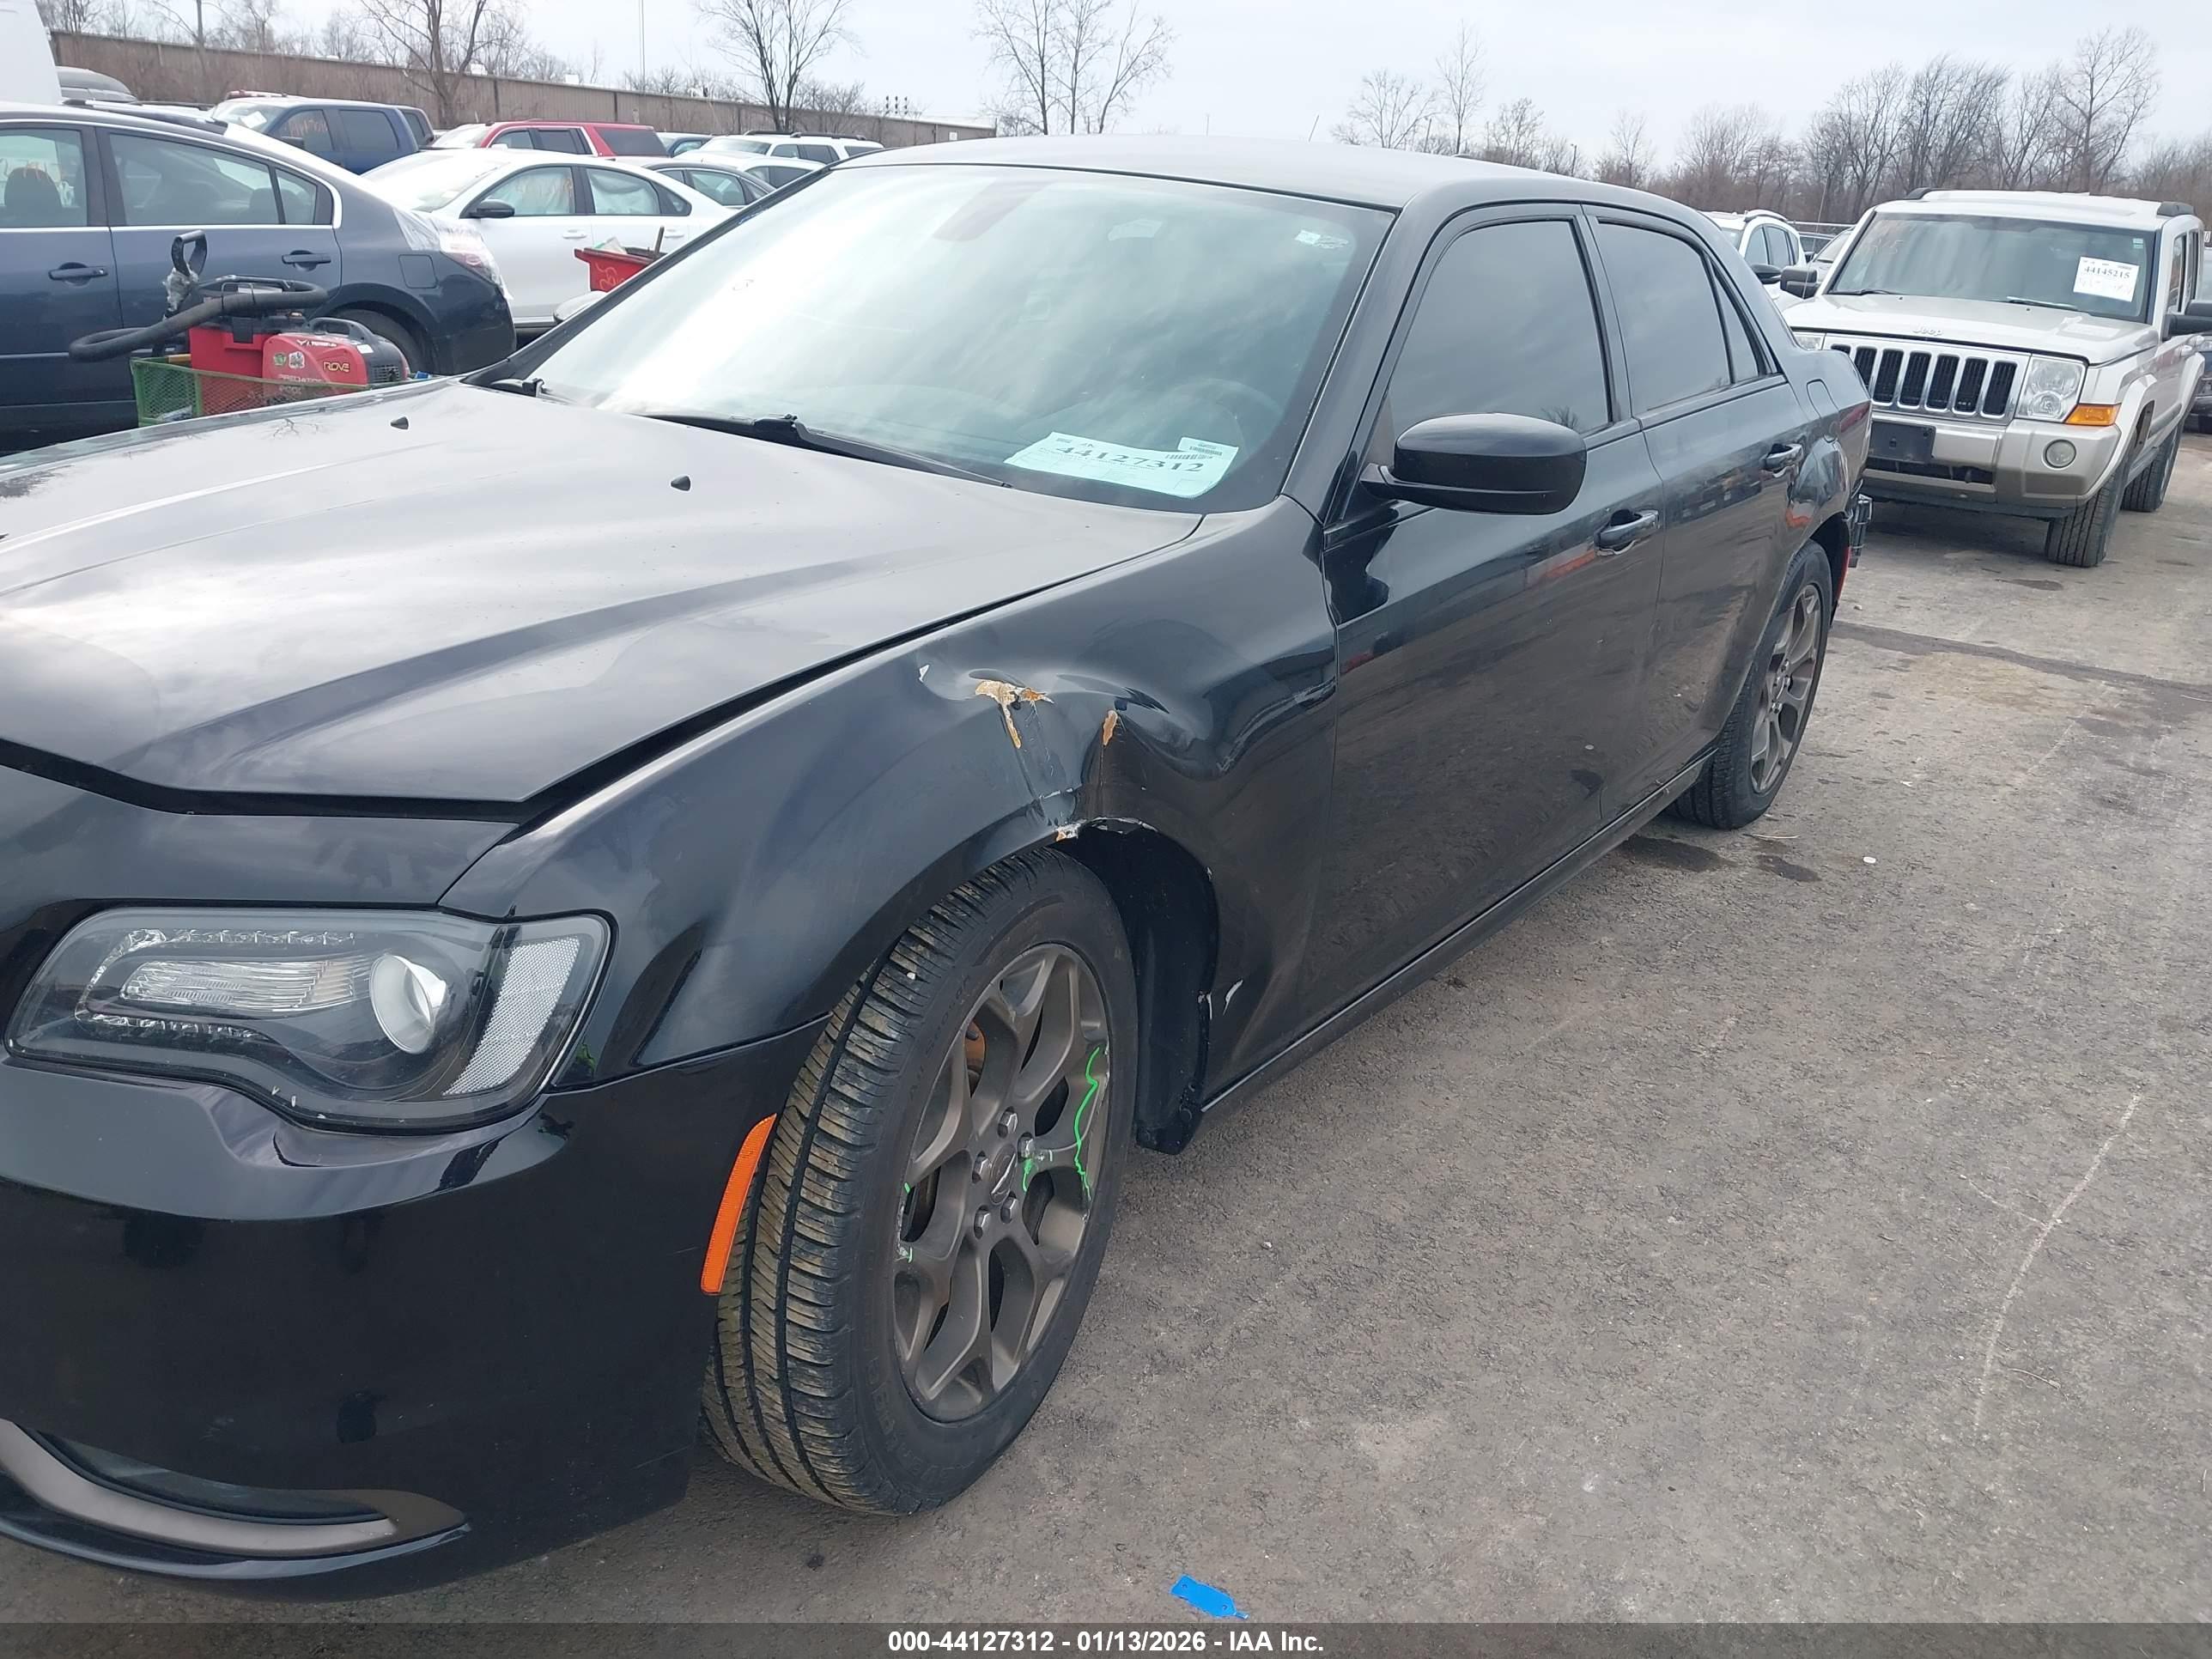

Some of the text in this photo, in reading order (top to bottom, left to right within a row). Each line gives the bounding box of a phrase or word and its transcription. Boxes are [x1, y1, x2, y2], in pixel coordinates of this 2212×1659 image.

[2083, 264, 2131, 280] 44145215
[1911, 323, 1943, 337] Jeep
[1055, 446, 1205, 472] 44127312
